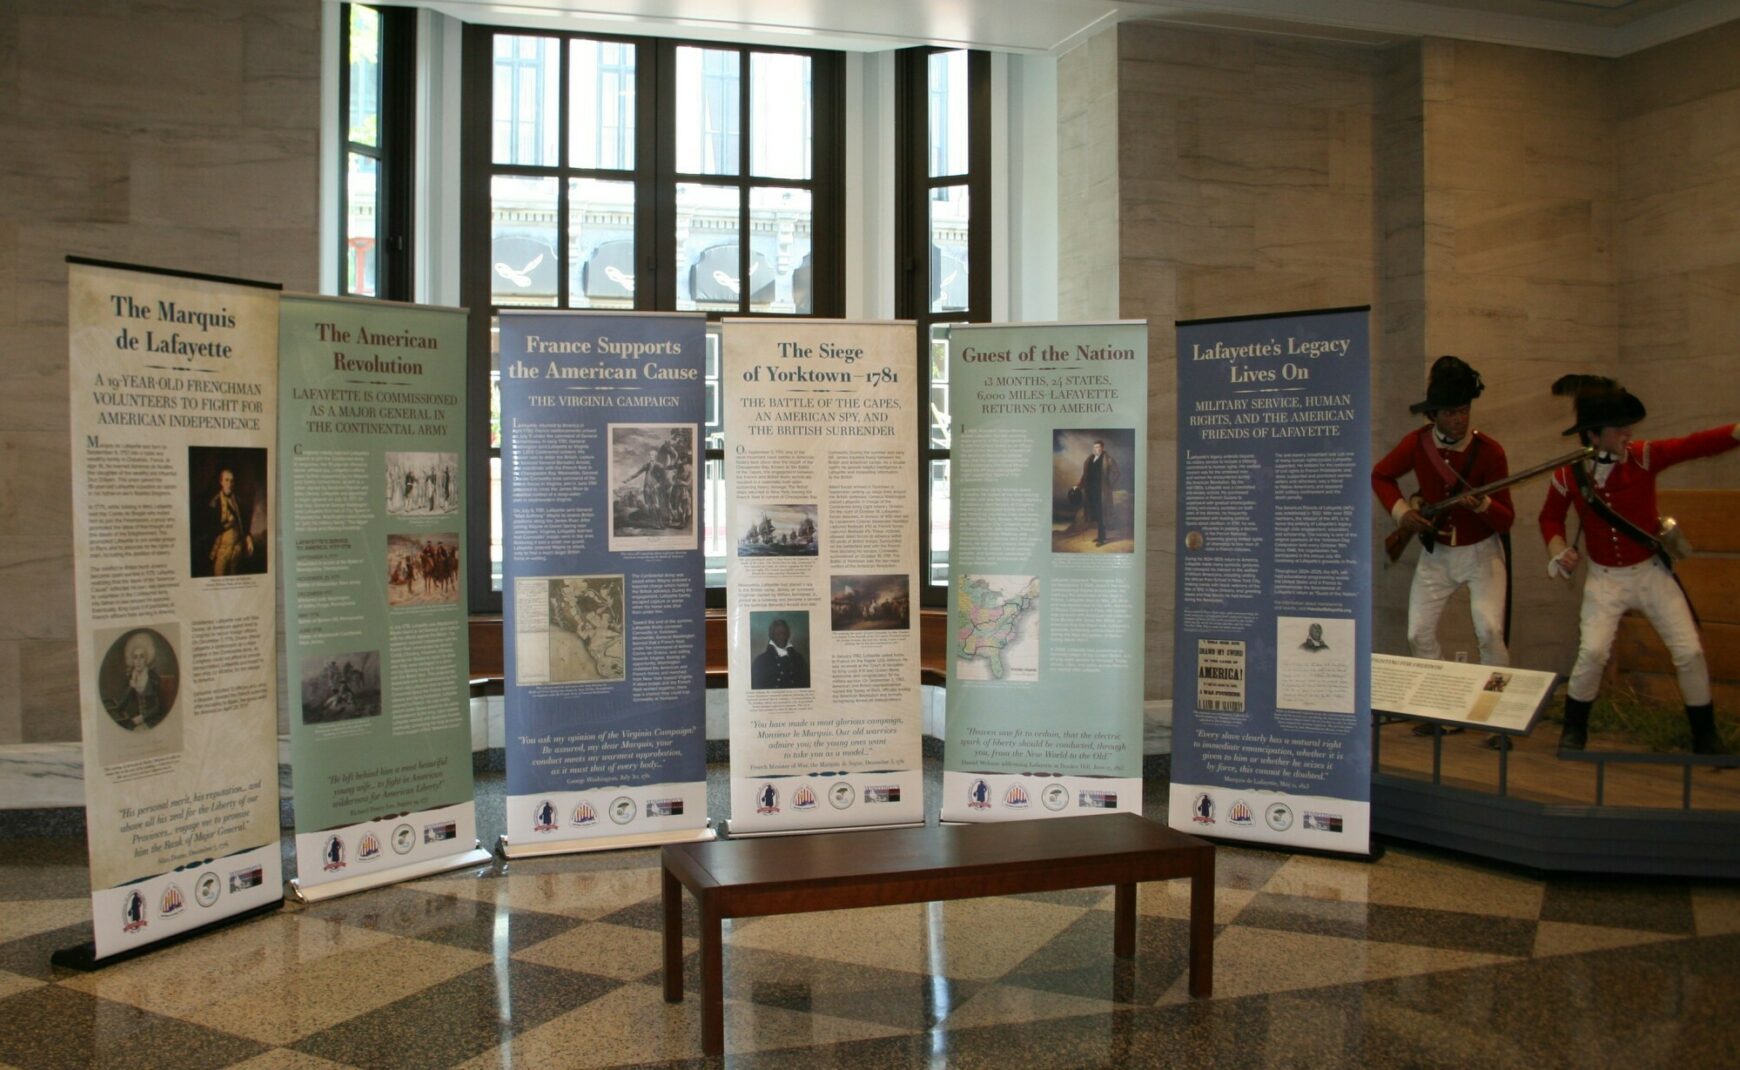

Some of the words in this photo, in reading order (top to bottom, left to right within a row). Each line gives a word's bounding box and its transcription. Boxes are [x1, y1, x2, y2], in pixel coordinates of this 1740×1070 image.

[111, 295, 151, 320] The
[158, 301, 236, 331] Marquis
[315, 323, 350, 343] The
[357, 327, 438, 349] American
[116, 329, 139, 351] de
[146, 332, 232, 361] Lafayette
[526, 336, 591, 353] France
[597, 337, 681, 359] Supports
[778, 342, 812, 358] The
[819, 343, 863, 363] Siege
[1193, 338, 1281, 363] Lafayette's
[1288, 338, 1350, 359] Legacy
[962, 347, 1012, 363] Guest
[1018, 345, 1036, 361] of
[1041, 346, 1069, 361] the
[1077, 345, 1134, 361] Nation
[334, 352, 423, 375] Revolution
[509, 361, 539, 378] the
[545, 362, 636, 380] American
[643, 364, 698, 380] Cause
[743, 366, 761, 382] of
[1231, 366, 1276, 383] Lives
[1282, 363, 1309, 380] On
[95, 374, 104, 386] A
[108, 375, 183, 391] 19-YEAR-OLD
[187, 380, 261, 395] FRENCHMAN
[984, 377, 993, 386] 13
[996, 376, 1048, 387] MONTHS,
[1052, 377, 1063, 388] 24
[1066, 375, 1111, 386] STATES,
[93, 392, 177, 408] VOLUNTEERS
[180, 397, 197, 410] TO
[201, 400, 239, 412] FIGHT
[242, 401, 263, 413] FOR
[293, 388, 360, 402] LAFAYETTE
[364, 392, 373, 401] IS
[376, 392, 458, 405] COMMISSIONED
[529, 396, 555, 406] THE
[560, 396, 613, 406] VIRGINIA
[617, 396, 680, 407] CAMPAIGN
[977, 390, 1005, 401] 6,000
[1196, 399, 1248, 411] MILITARY
[1252, 398, 1302, 409] SERVICE,
[1306, 395, 1350, 407] HUMAN
[741, 398, 766, 408] THE
[770, 398, 814, 408] BATTLE
[818, 399, 832, 408] OF
[836, 399, 860, 408] THE
[863, 399, 902, 410] CAPES,
[982, 404, 1036, 414] RETURNS
[1040, 404, 1056, 412] TO
[1059, 403, 1113, 413] AMERICA
[310, 406, 325, 416] AS
[328, 406, 336, 417] A
[339, 407, 376, 418] MAJOR
[380, 408, 431, 419] GENERAL
[434, 409, 445, 420] IN
[756, 412, 771, 421] AN
[775, 413, 836, 421] AMERICAN
[839, 413, 860, 423] SPY,
[864, 413, 888, 421] AND
[1190, 414, 1231, 426] RIGHTS,
[1235, 413, 1259, 424] AND
[1263, 412, 1288, 423] THE
[1292, 410, 1355, 421] AMERICAN
[97, 413, 166, 426] AMERICAN
[169, 415, 260, 430] INDEPENDENCE
[307, 422, 332, 433] THE
[335, 423, 415, 435] CONTINENTAL
[418, 425, 448, 436] ARMY
[748, 426, 773, 435] THE
[777, 426, 822, 435] BRITISH
[826, 426, 895, 436] SURRENDER
[1202, 428, 1249, 439] FRIENDS
[1252, 428, 1269, 438] OF
[1272, 425, 1340, 438] LAFAYETTE
[1199, 667, 1242, 680] AMERICA!
[789, 719, 807, 727] made
[835, 718, 865, 729] glorious
[568, 735, 595, 743] opinion
[598, 731, 606, 741] of
[622, 730, 652, 738] Virginia
[813, 739, 824, 748] the
[826, 740, 848, 749] young
[1222, 731, 1239, 740] slave
[1242, 733, 1266, 744] clearly
[1270, 735, 1282, 743] has
[1292, 737, 1320, 747] natural
[1323, 740, 1342, 749] right
[554, 744, 585, 753] assured,
[588, 744, 598, 752] my
[602, 741, 619, 750] dear
[621, 741, 653, 750] Marquis,
[657, 740, 672, 748] your
[533, 757, 562, 765] conduct
[564, 756, 585, 764] meets
[588, 755, 599, 763] my
[602, 753, 633, 761] warmest
[636, 750, 682, 760] approbation,
[793, 750, 808, 759] take
[810, 751, 823, 760] you
[591, 764, 605, 772] that
[608, 762, 615, 772] of
[617, 762, 637, 771] every
[1207, 763, 1215, 772] by
[1240, 766, 1253, 774] this
[1255, 768, 1281, 776] cannot
[1283, 769, 1292, 777] be
[137, 802, 168, 816] personal
[194, 792, 204, 803] his
[249, 780, 261, 790] and
